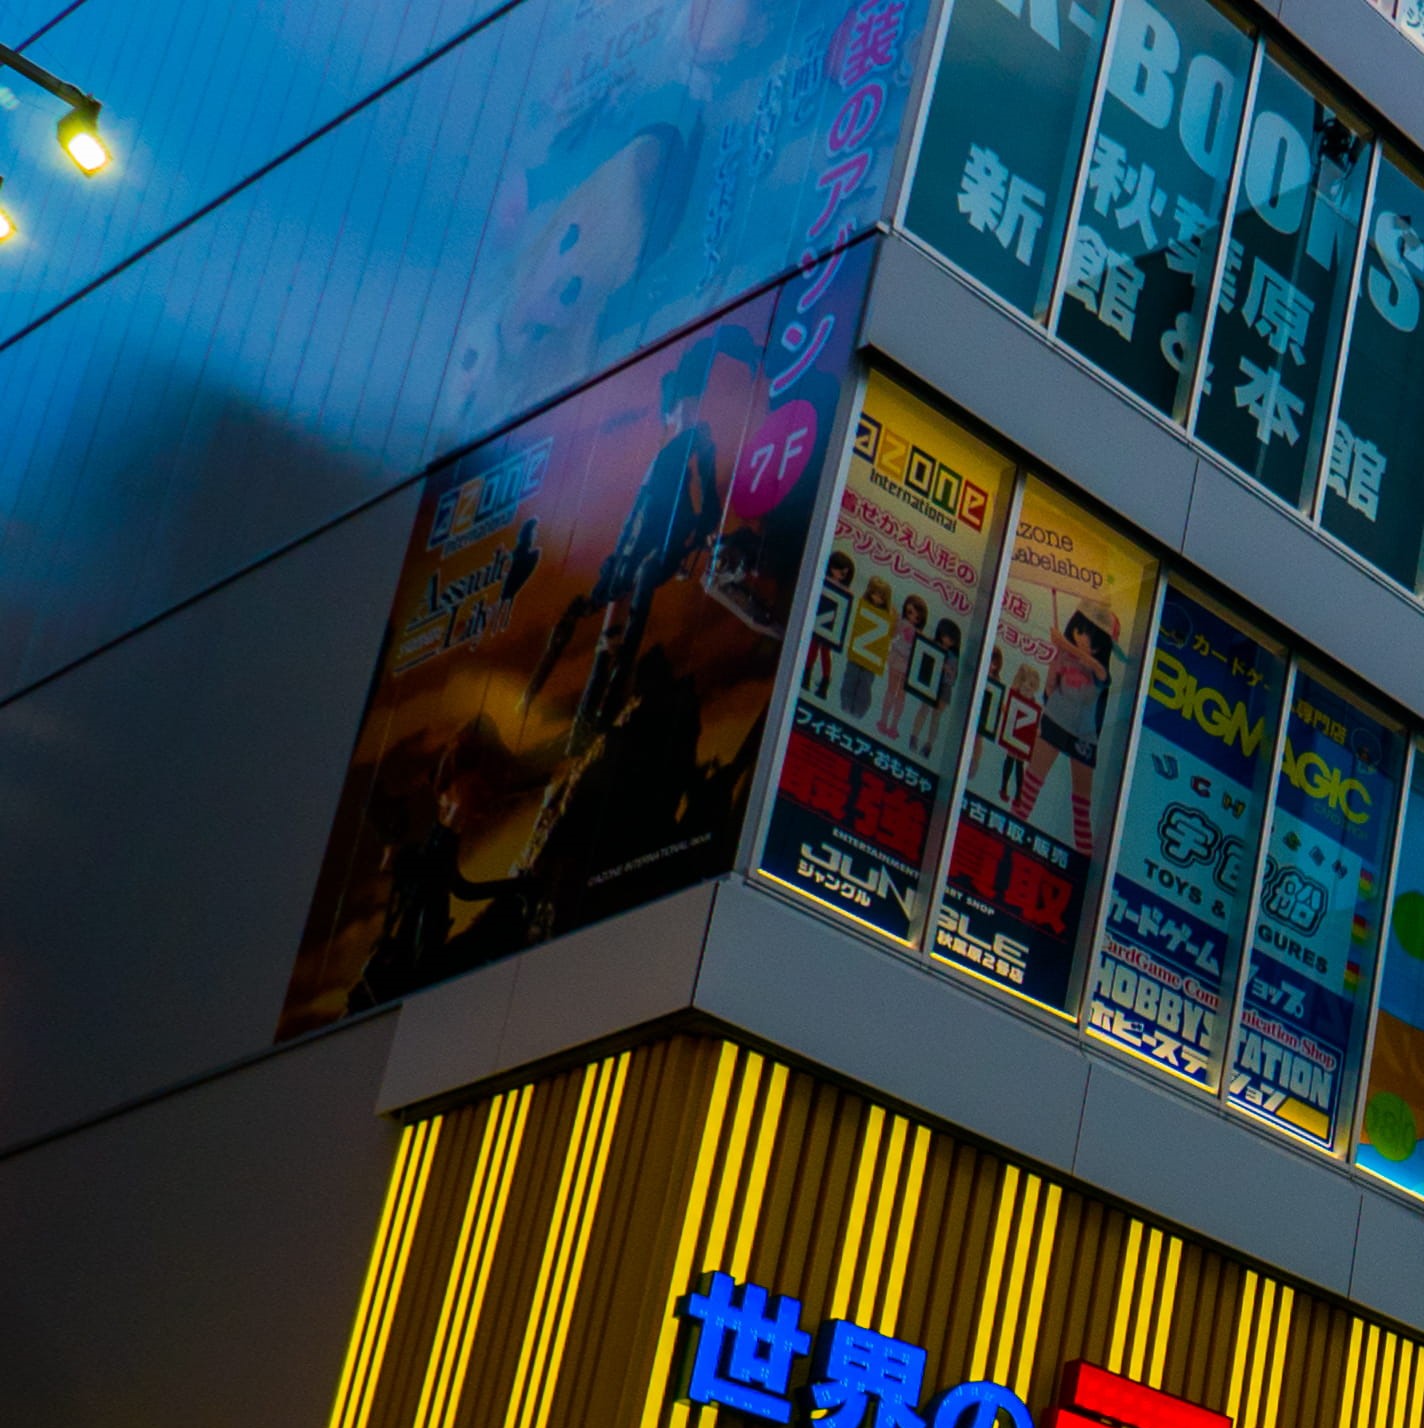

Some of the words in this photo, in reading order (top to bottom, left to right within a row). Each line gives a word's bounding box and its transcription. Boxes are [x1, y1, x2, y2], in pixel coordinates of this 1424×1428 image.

[770, 0, 904, 397] 装のアゾン
[749, 426, 808, 493] 7F
[854, 411, 989, 533] azone
[870, 467, 957, 534] International
[1014, 519, 1075, 555] zone
[1144, 858, 1202, 906] TOYS
[1301, 1036, 1337, 1073] Shop
